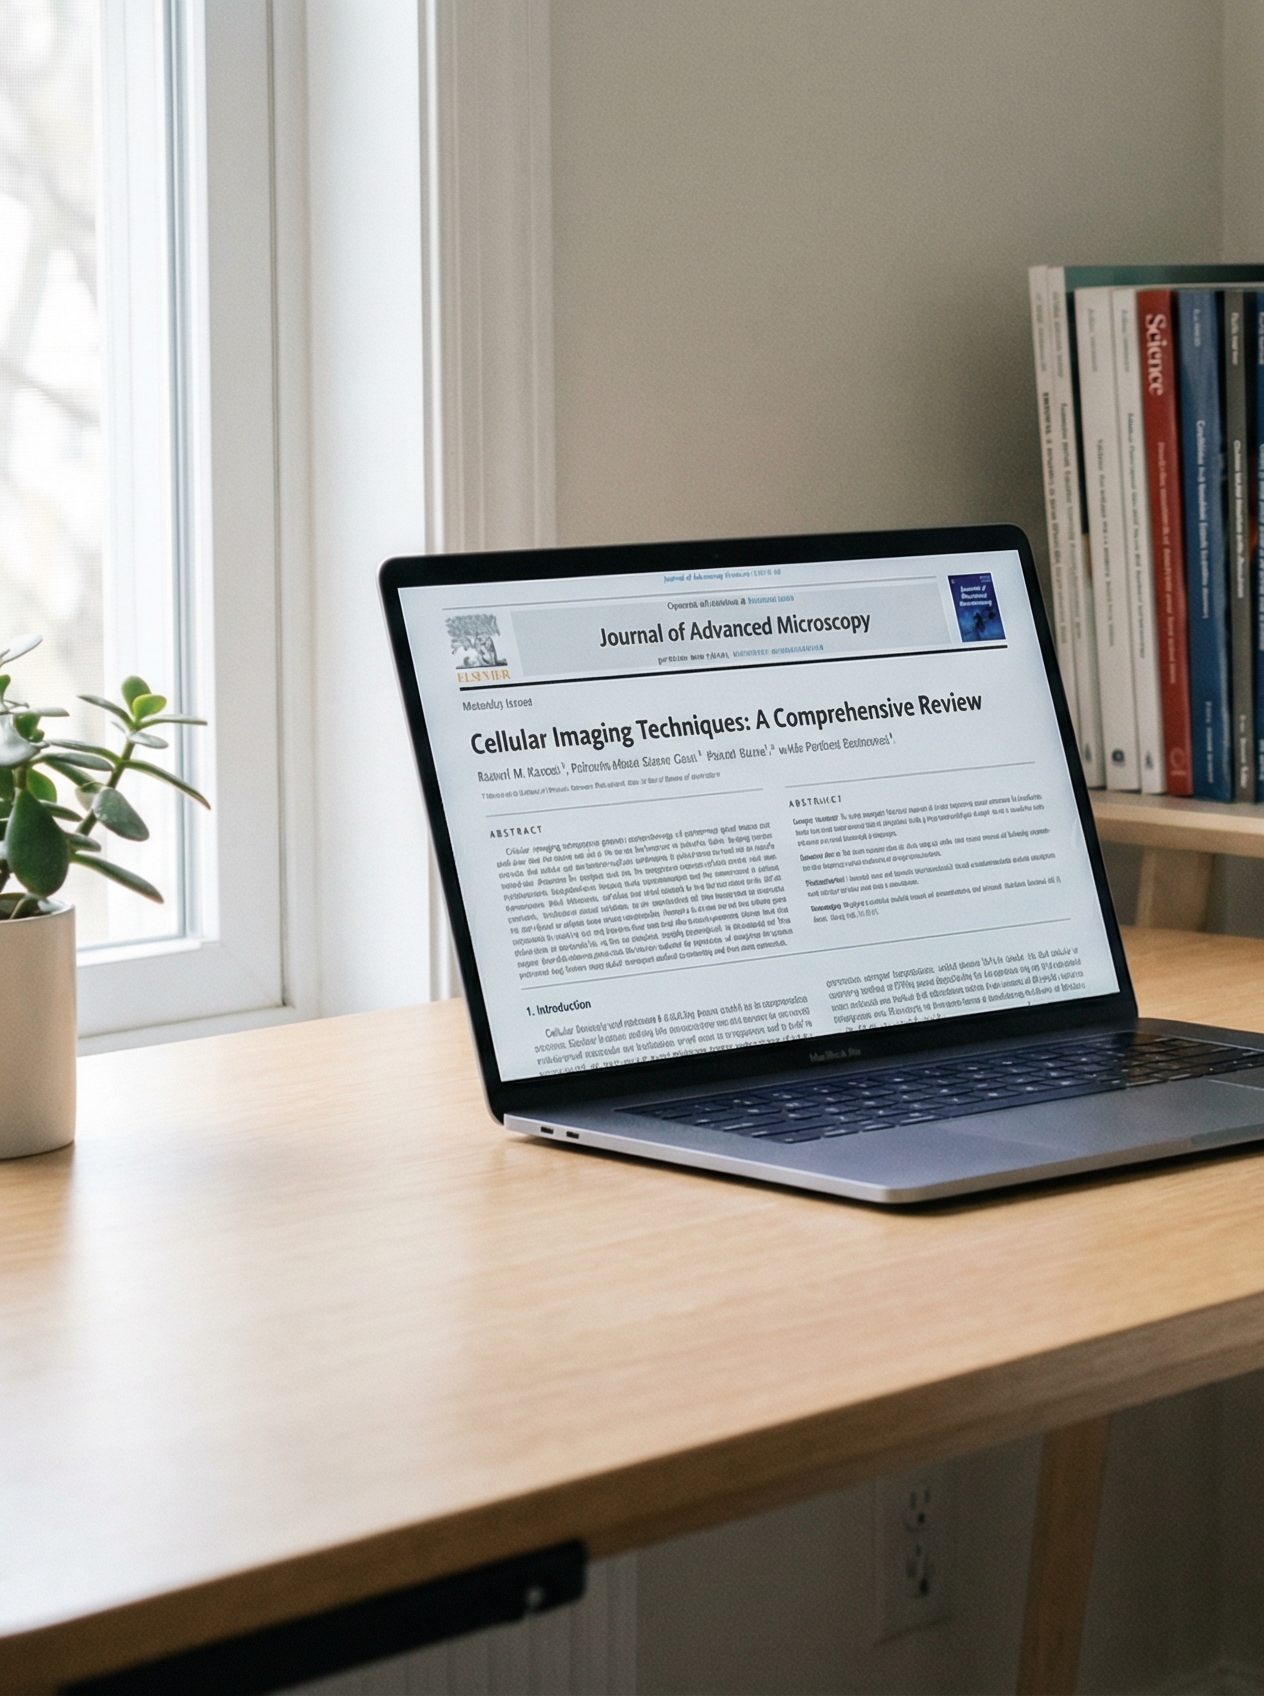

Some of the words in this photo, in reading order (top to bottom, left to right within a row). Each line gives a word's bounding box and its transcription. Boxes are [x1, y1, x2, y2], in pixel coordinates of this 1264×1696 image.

[1145, 313, 1168, 397] Science
[599, 623, 664, 648] Journal
[668, 622, 686, 642] of
[690, 616, 773, 641] Advanced
[776, 614, 871, 634] Microscopy
[470, 728, 547, 755] Cellular
[552, 722, 634, 750] Imaging
[635, 714, 751, 740] Techniques:
[756, 709, 770, 730] A
[773, 697, 915, 730] Comprehensive
[918, 692, 982, 715] Review
[489, 825, 542, 839] ABSTRACT
[526, 1006, 535, 1017] 1.
[536, 1000, 592, 1016] Introduction
